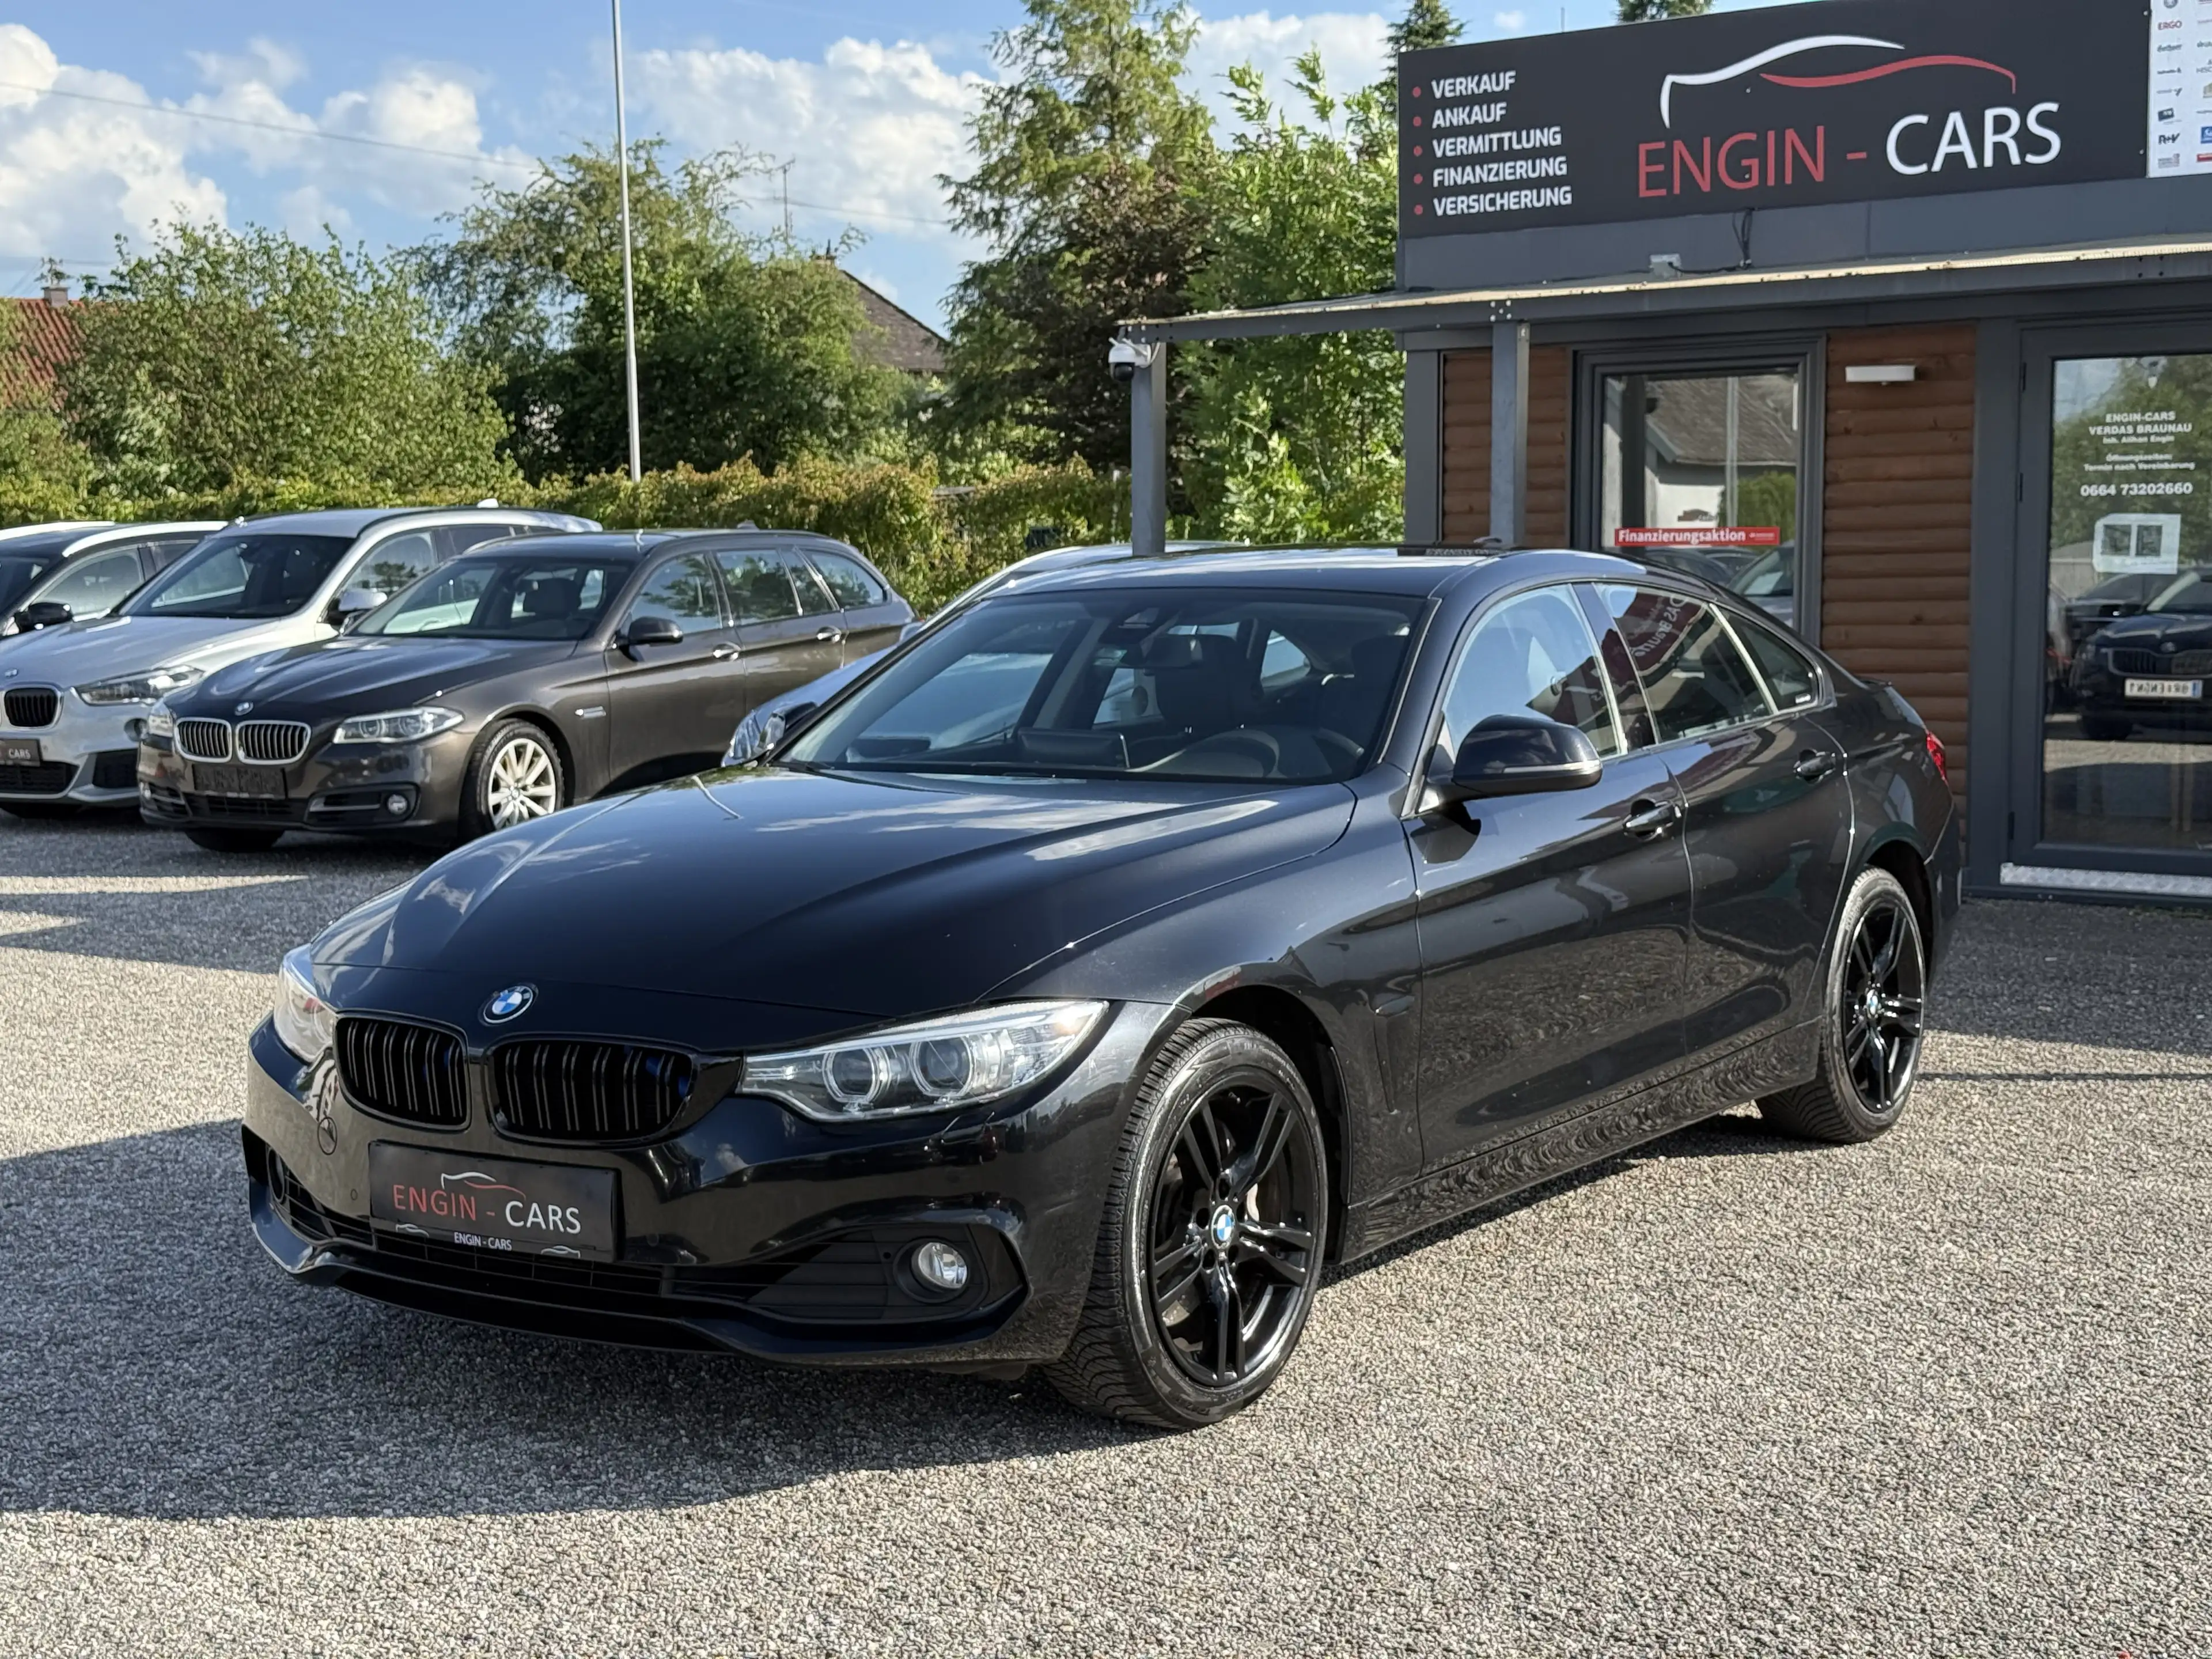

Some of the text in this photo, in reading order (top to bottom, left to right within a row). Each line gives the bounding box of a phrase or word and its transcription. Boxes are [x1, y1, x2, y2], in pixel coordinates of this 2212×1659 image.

[1431, 70, 1516, 100] VERKAUF
[1432, 102, 1507, 129] ANKAUF
[1433, 127, 1562, 158] VERMITTLUNG
[1638, 126, 1825, 198] ENGIN
[1886, 101, 2061, 176] CARS
[1433, 156, 1567, 188] FINANZIERUNG
[1433, 185, 1572, 216] VERSICHERUNG
[2105, 411, 2176, 423] ENGIN-CARS
[2137, 423, 2192, 434] BRAUNAU
[1618, 529, 1746, 545] Finanzierungsaktion
[393, 1184, 476, 1221] ENGIN
[505, 1200, 581, 1234] CARS
[454, 1232, 482, 1247] ENGIN
[488, 1237, 512, 1252] CARS
